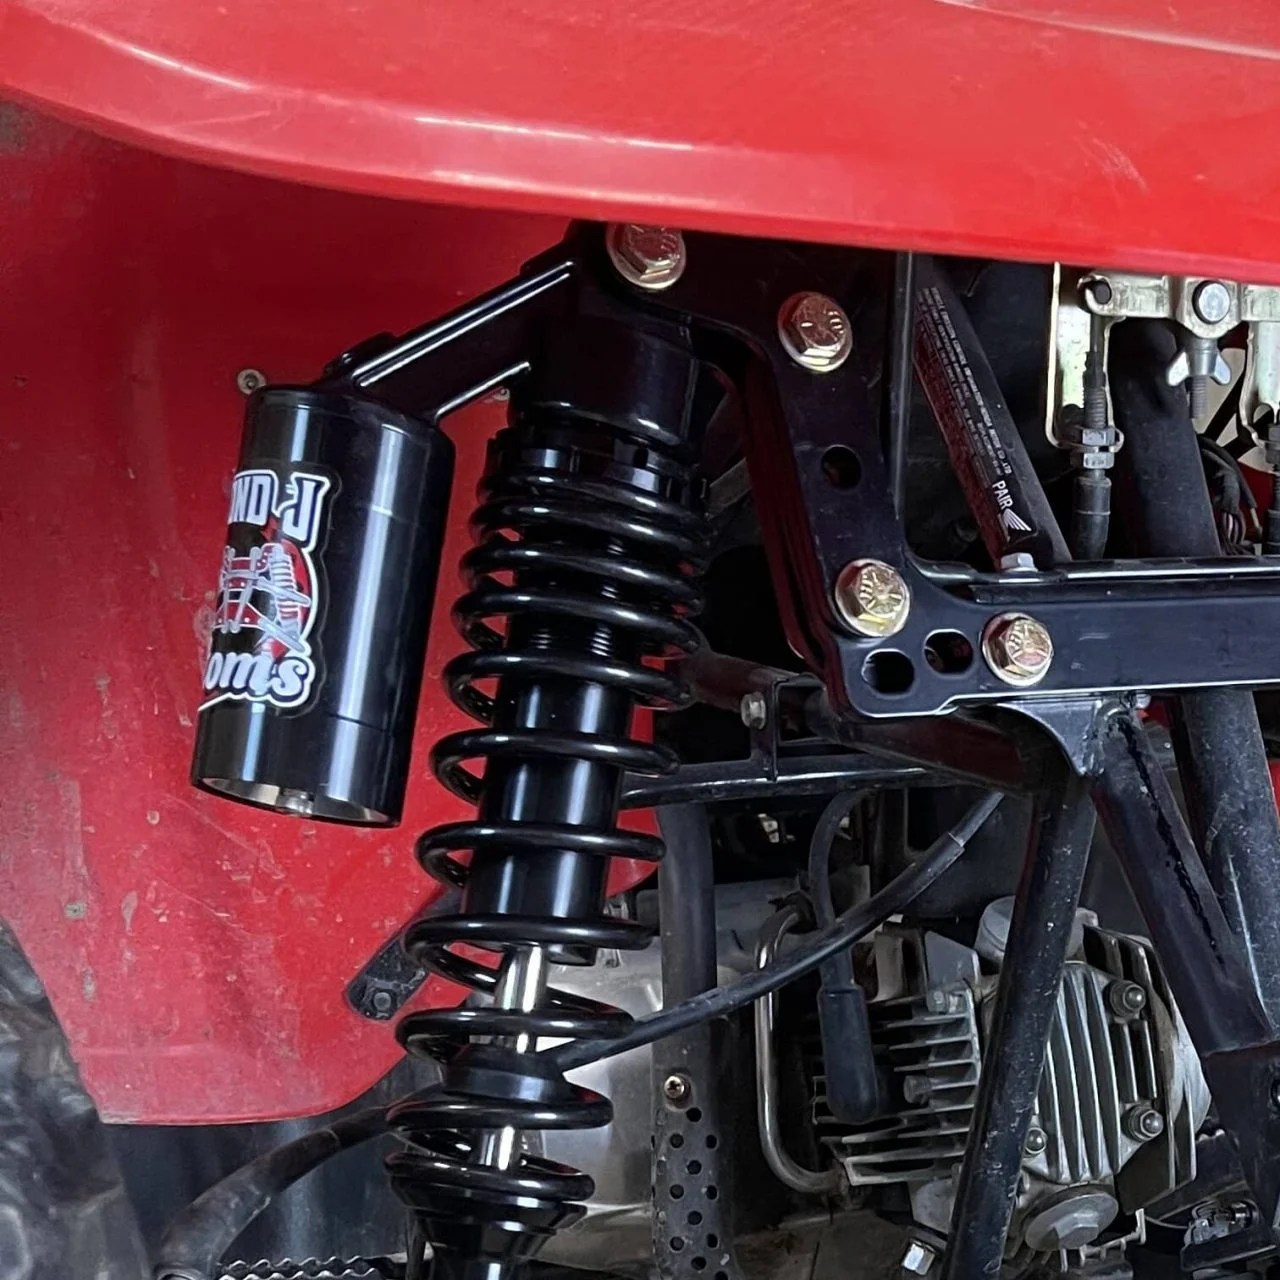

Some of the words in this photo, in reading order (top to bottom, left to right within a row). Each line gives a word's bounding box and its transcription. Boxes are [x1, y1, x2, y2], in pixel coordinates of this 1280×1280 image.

[230, 476, 272, 526] ND
[992, 479, 1014, 510] PAIR
[203, 651, 308, 697] oms
